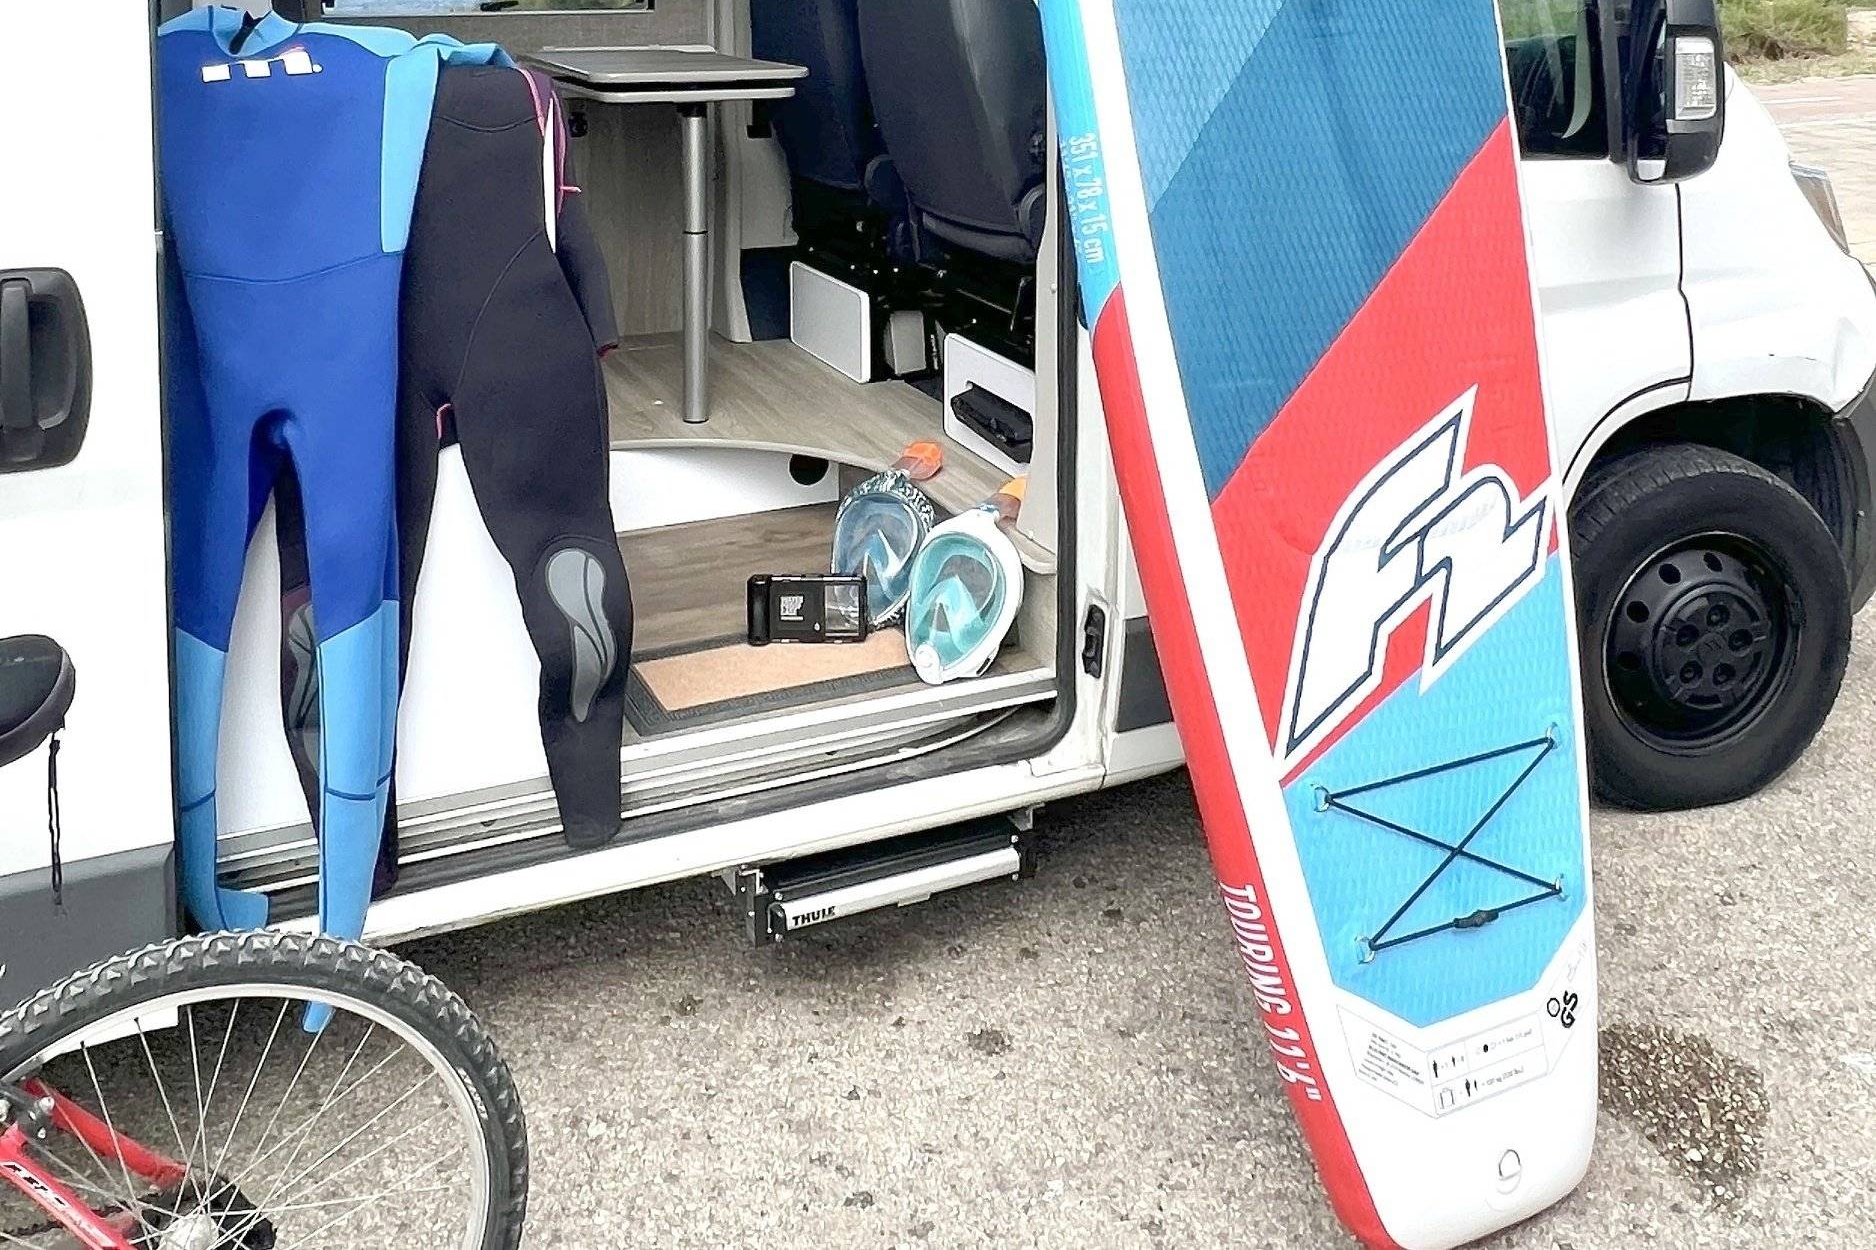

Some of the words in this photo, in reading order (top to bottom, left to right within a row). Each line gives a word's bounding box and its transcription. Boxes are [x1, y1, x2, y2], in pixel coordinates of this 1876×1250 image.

[1069, 132, 1099, 163] 351
[1075, 177, 1103, 199] 78
[1081, 214, 1109, 235] 15
[1083, 238, 1105, 263] cm
[1277, 386, 1552, 762] F2
[1219, 880, 1293, 1015] TOURING
